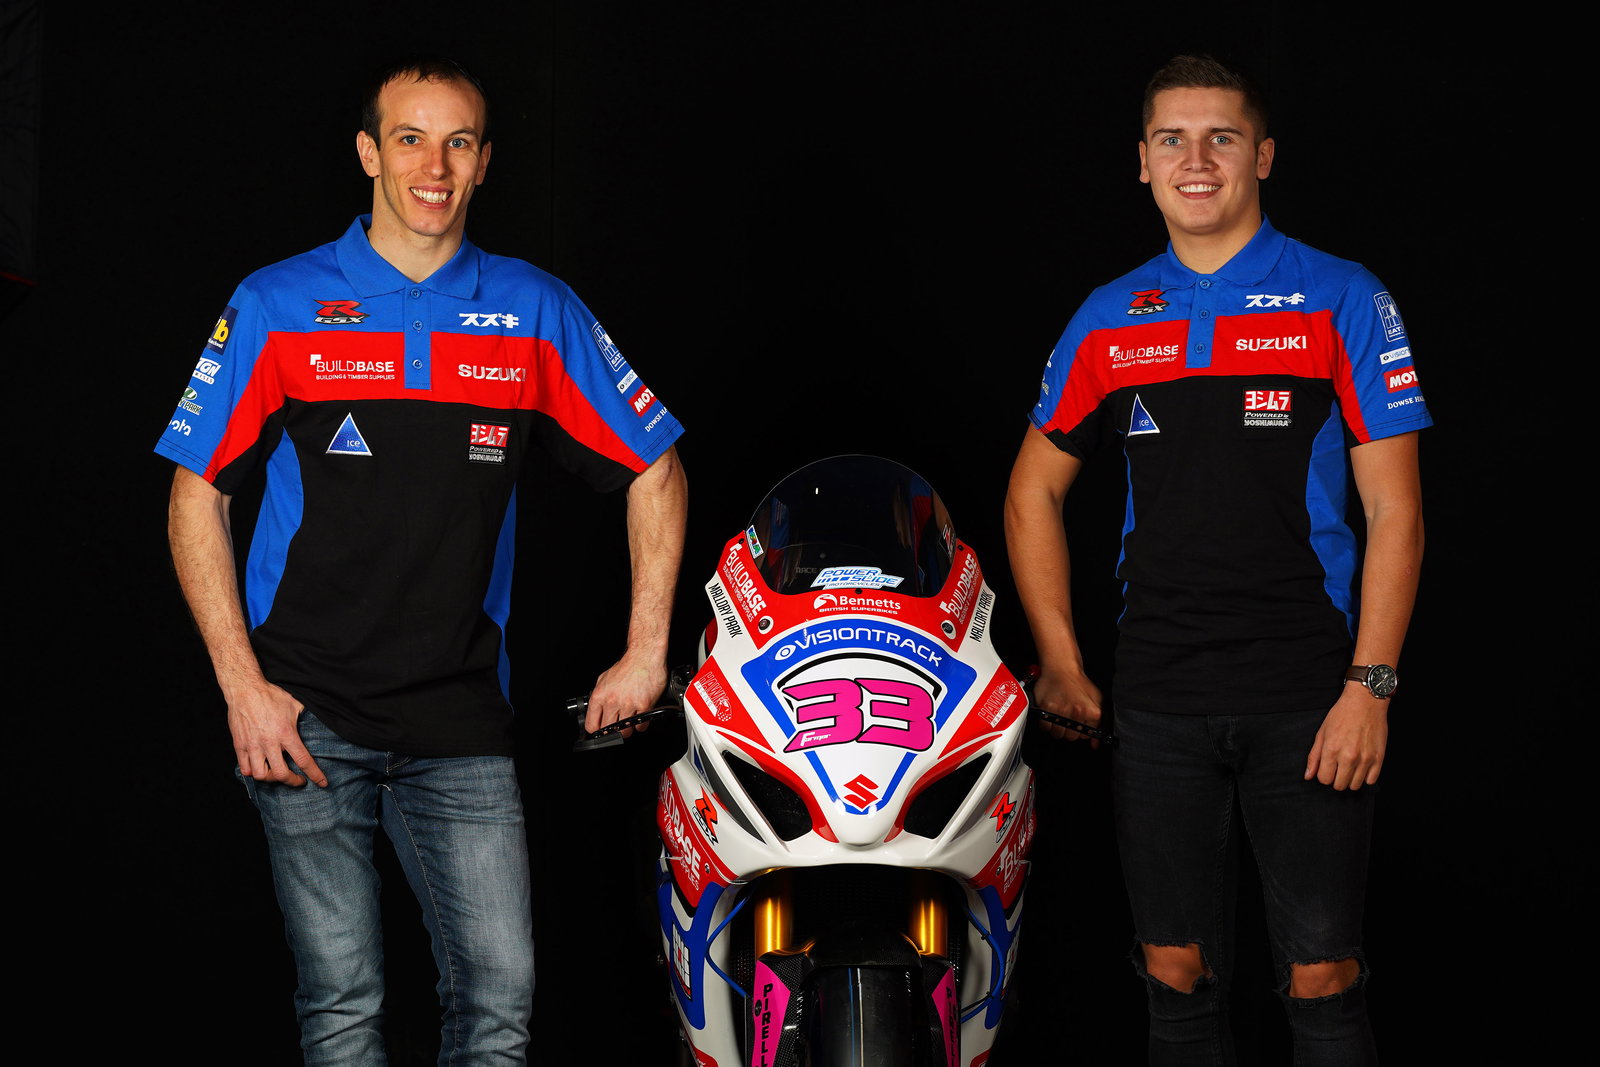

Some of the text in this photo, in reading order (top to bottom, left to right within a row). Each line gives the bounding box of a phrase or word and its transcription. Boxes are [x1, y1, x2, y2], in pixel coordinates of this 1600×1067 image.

[1245, 292, 1306, 308] スズキ
[458, 313, 519, 329] スズキ
[1235, 335, 1307, 351] SUZUKI
[1113, 345, 1179, 362] BUILDBASE
[316, 360, 395, 373] BUILDBASE
[458, 364, 526, 382] SUZUKI
[1245, 391, 1290, 410] ヨシムラ
[1387, 397, 1414, 410] DOWSE
[644, 412, 662, 433] DOWSE
[471, 424, 508, 445] ヨシムラ
[821, 568, 879, 578] POWER
[851, 575, 898, 585] SLIDE
[726, 550, 767, 617] BUILDBASE
[948, 553, 977, 618] BUILDBASE
[708, 582, 744, 639] MALLORY PARK
[839, 595, 901, 610] Bennetts
[851, 606, 898, 615] SUPERBIKES
[969, 608, 988, 643] MALLORY
[981, 589, 994, 612] PARK
[794, 627, 943, 667] VISIONTRACK
[782, 678, 935, 753] 33
